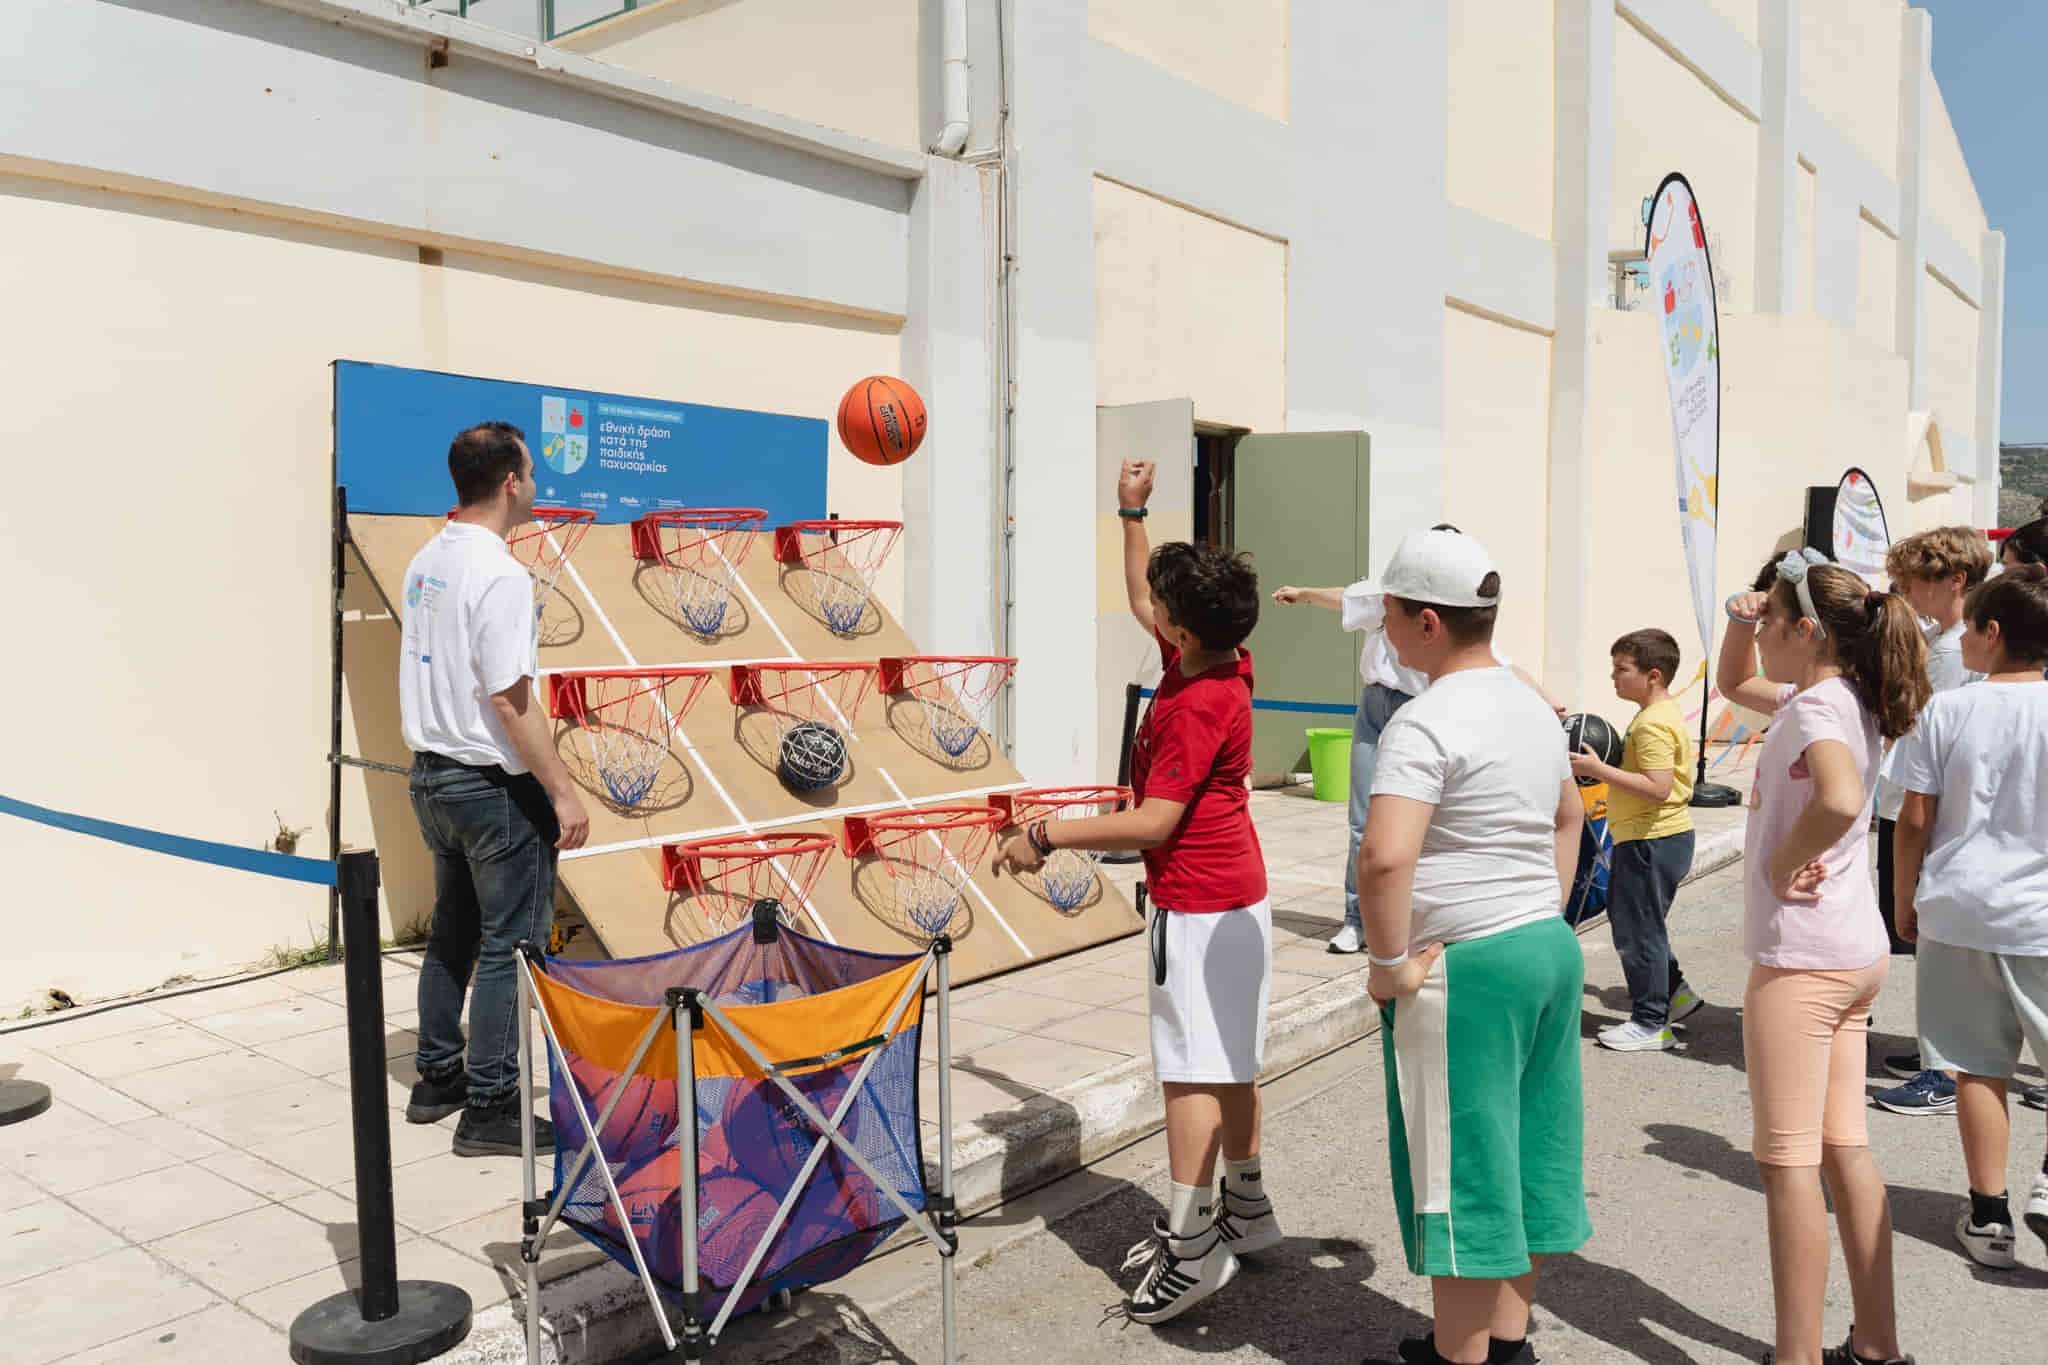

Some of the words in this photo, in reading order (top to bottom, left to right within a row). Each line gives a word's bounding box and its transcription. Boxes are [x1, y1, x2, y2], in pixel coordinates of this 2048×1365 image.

[599, 421, 635, 435] εθνική
[637, 424, 671, 440] δράση
[599, 435, 627, 447] κατά
[629, 438, 648, 450] της
[599, 447, 645, 461] παιδικής
[599, 458, 668, 476] παχυσαρκίας
